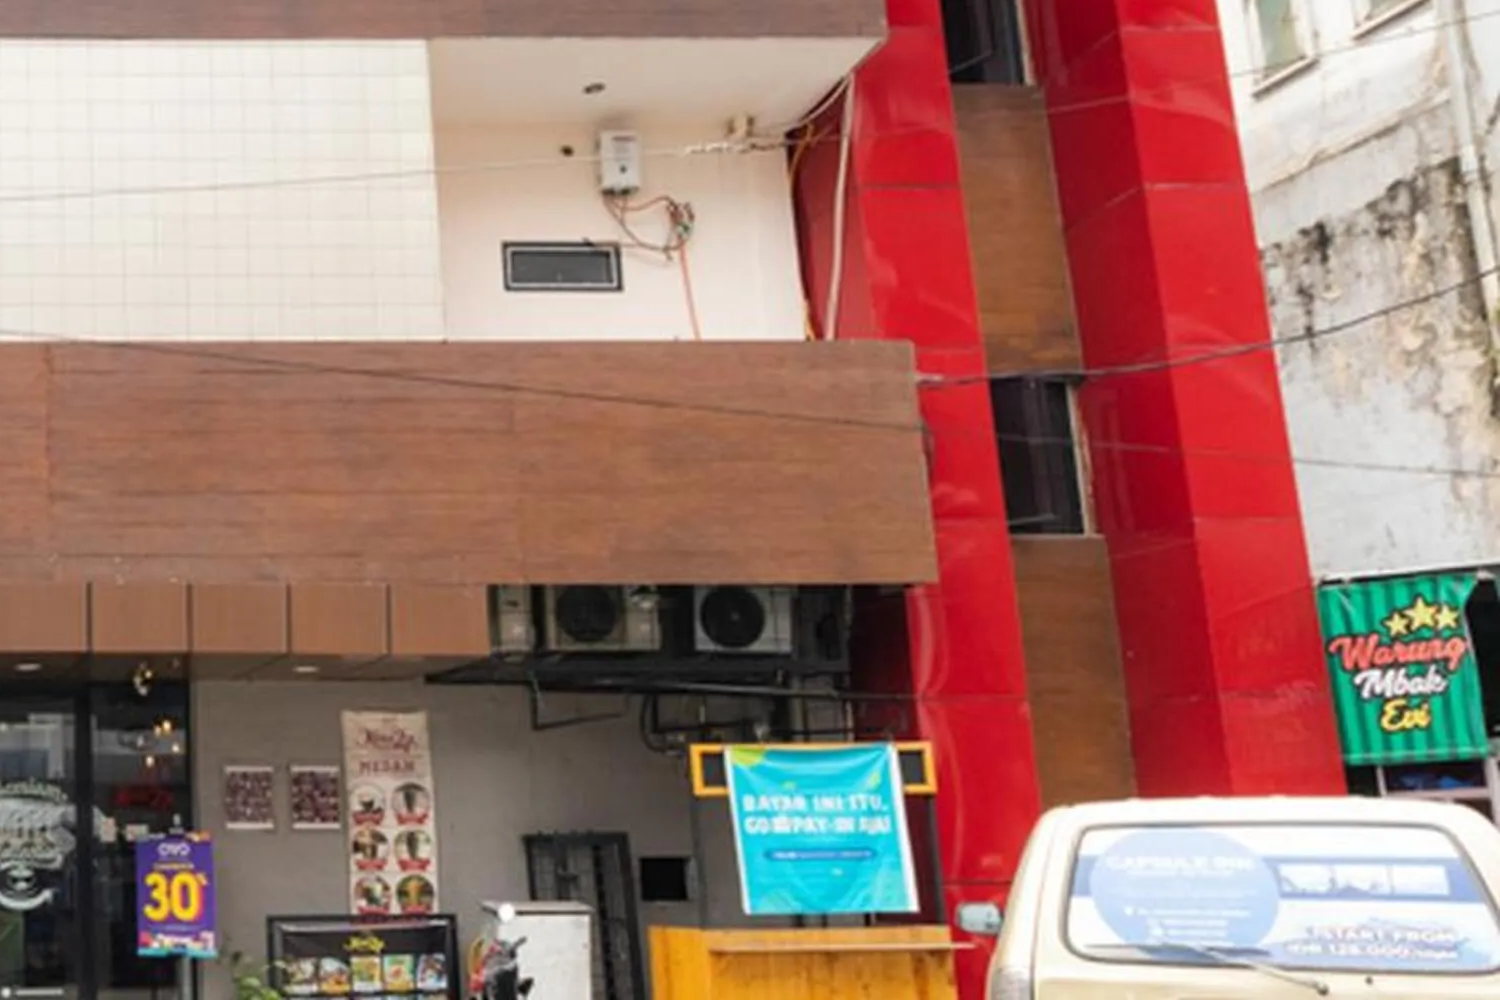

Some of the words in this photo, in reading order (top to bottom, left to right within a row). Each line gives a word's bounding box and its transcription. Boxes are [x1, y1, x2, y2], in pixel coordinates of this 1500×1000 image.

[1328, 633, 1468, 671] Warung
[1353, 665, 1449, 699] Mbak
[1381, 698, 1432, 732] Evi
